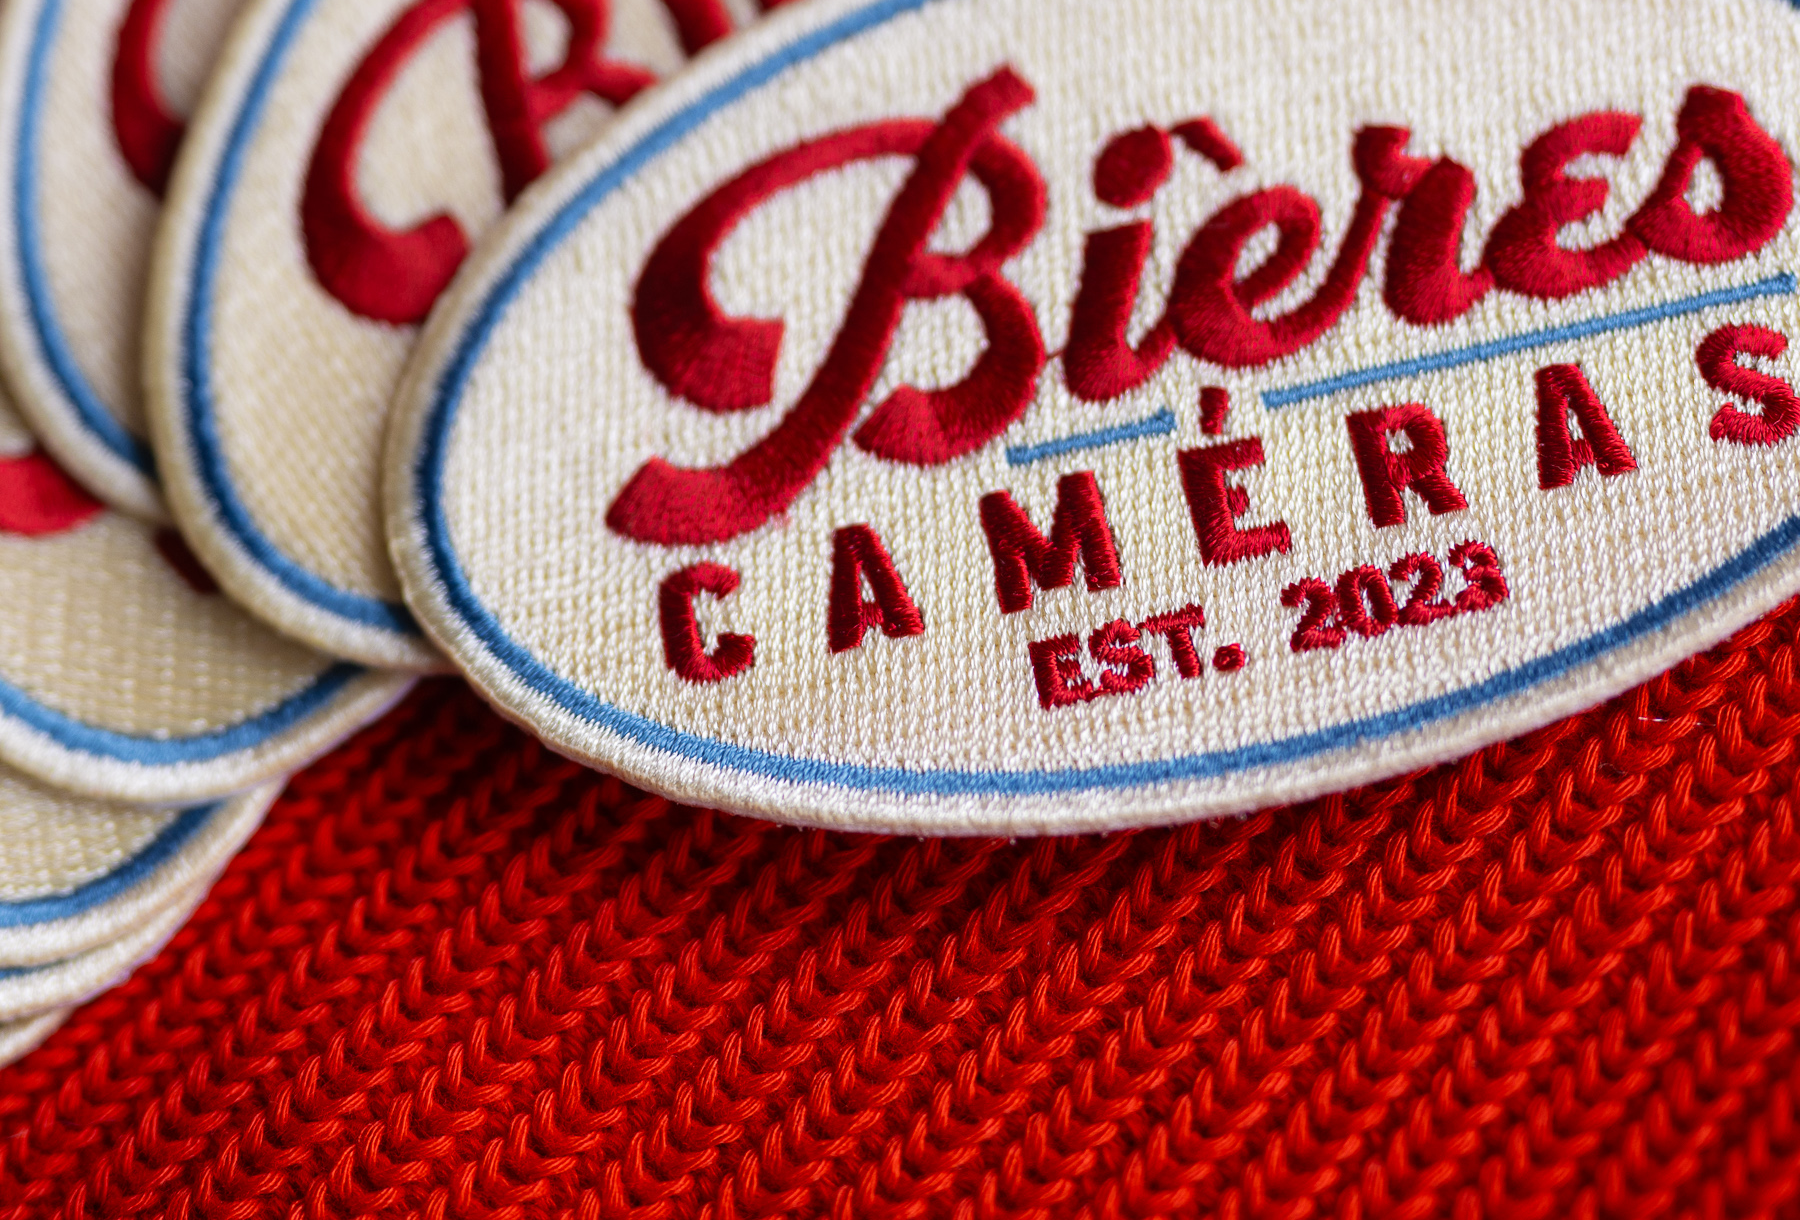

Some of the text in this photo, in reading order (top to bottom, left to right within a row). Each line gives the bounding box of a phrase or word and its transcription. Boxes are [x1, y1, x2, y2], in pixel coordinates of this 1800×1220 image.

[604, 62, 1794, 547] Bières
[659, 323, 1800, 684] CAMÉRAS
[1028, 540, 1511, 711] EST. 2023
